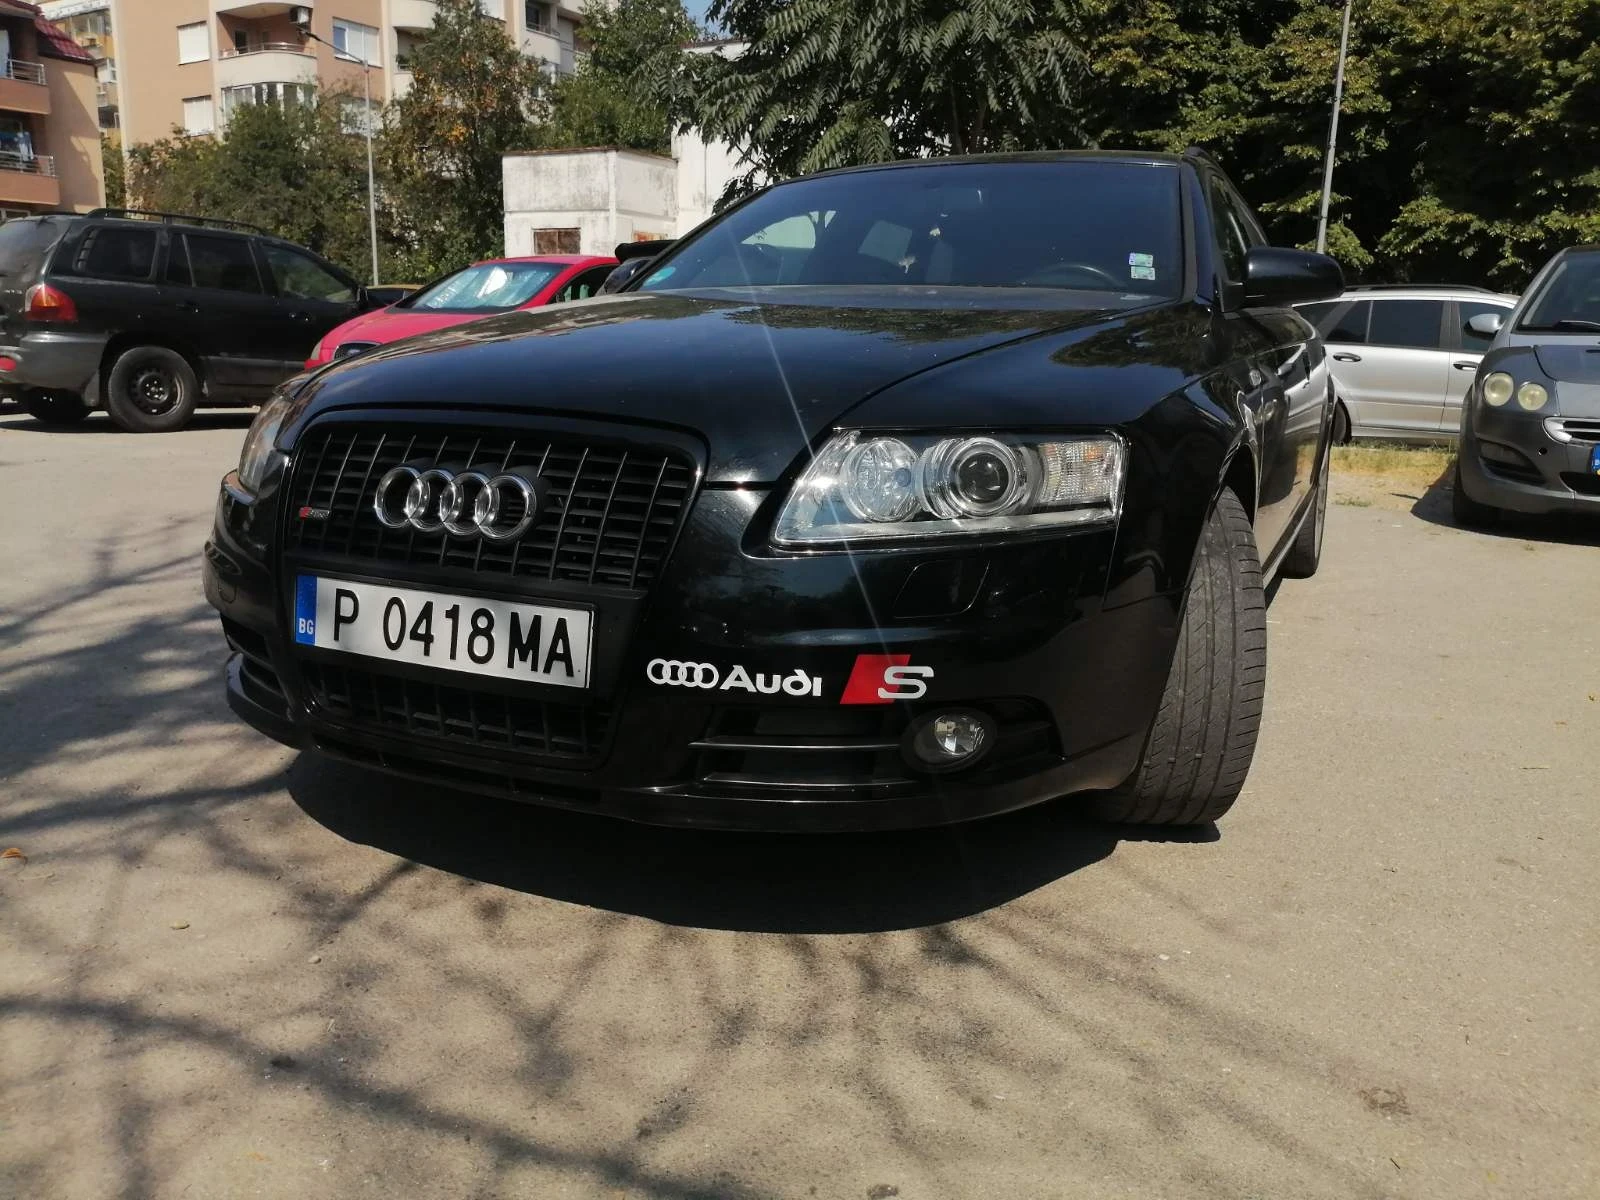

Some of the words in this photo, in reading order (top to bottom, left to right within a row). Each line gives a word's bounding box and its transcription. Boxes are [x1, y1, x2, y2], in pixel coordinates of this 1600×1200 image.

[298, 617, 314, 635] BG
[333, 588, 360, 642] P
[383, 596, 496, 665] 0418
[507, 611, 574, 678] MA
[719, 664, 822, 697] Audi
[877, 665, 935, 699] S
